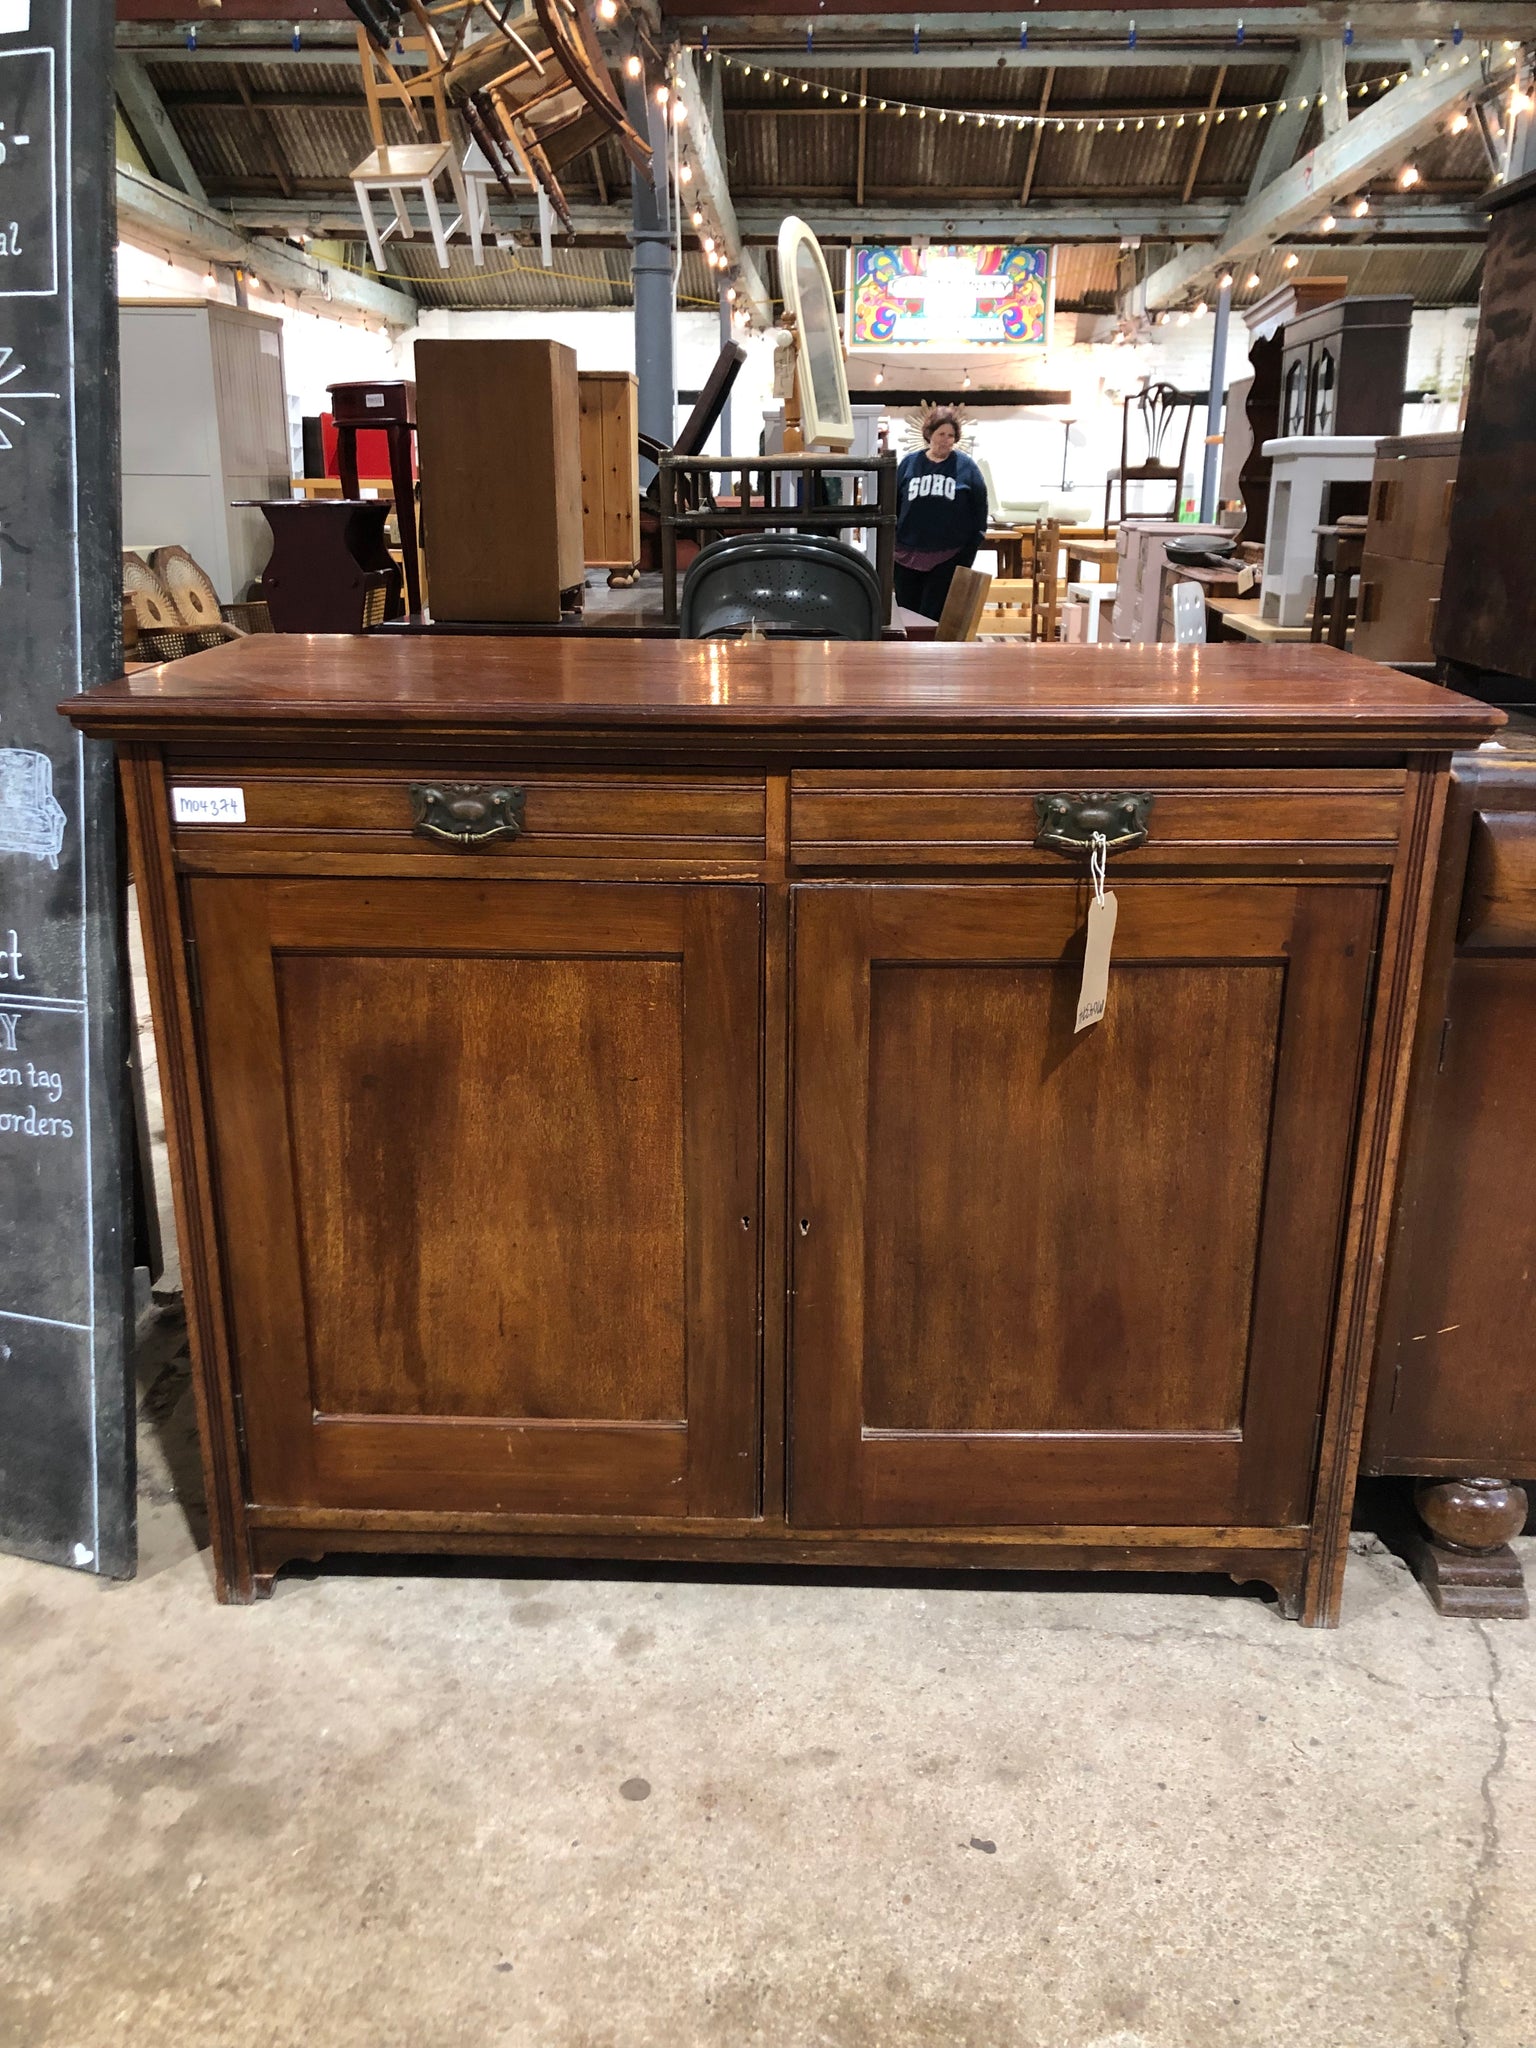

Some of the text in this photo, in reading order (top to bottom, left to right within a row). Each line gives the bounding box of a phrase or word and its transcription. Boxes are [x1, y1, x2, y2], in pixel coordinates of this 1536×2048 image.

[908, 473, 956, 501] SOHO
[27, 1062, 63, 1103] tag
[0, 1104, 74, 1138] orders
